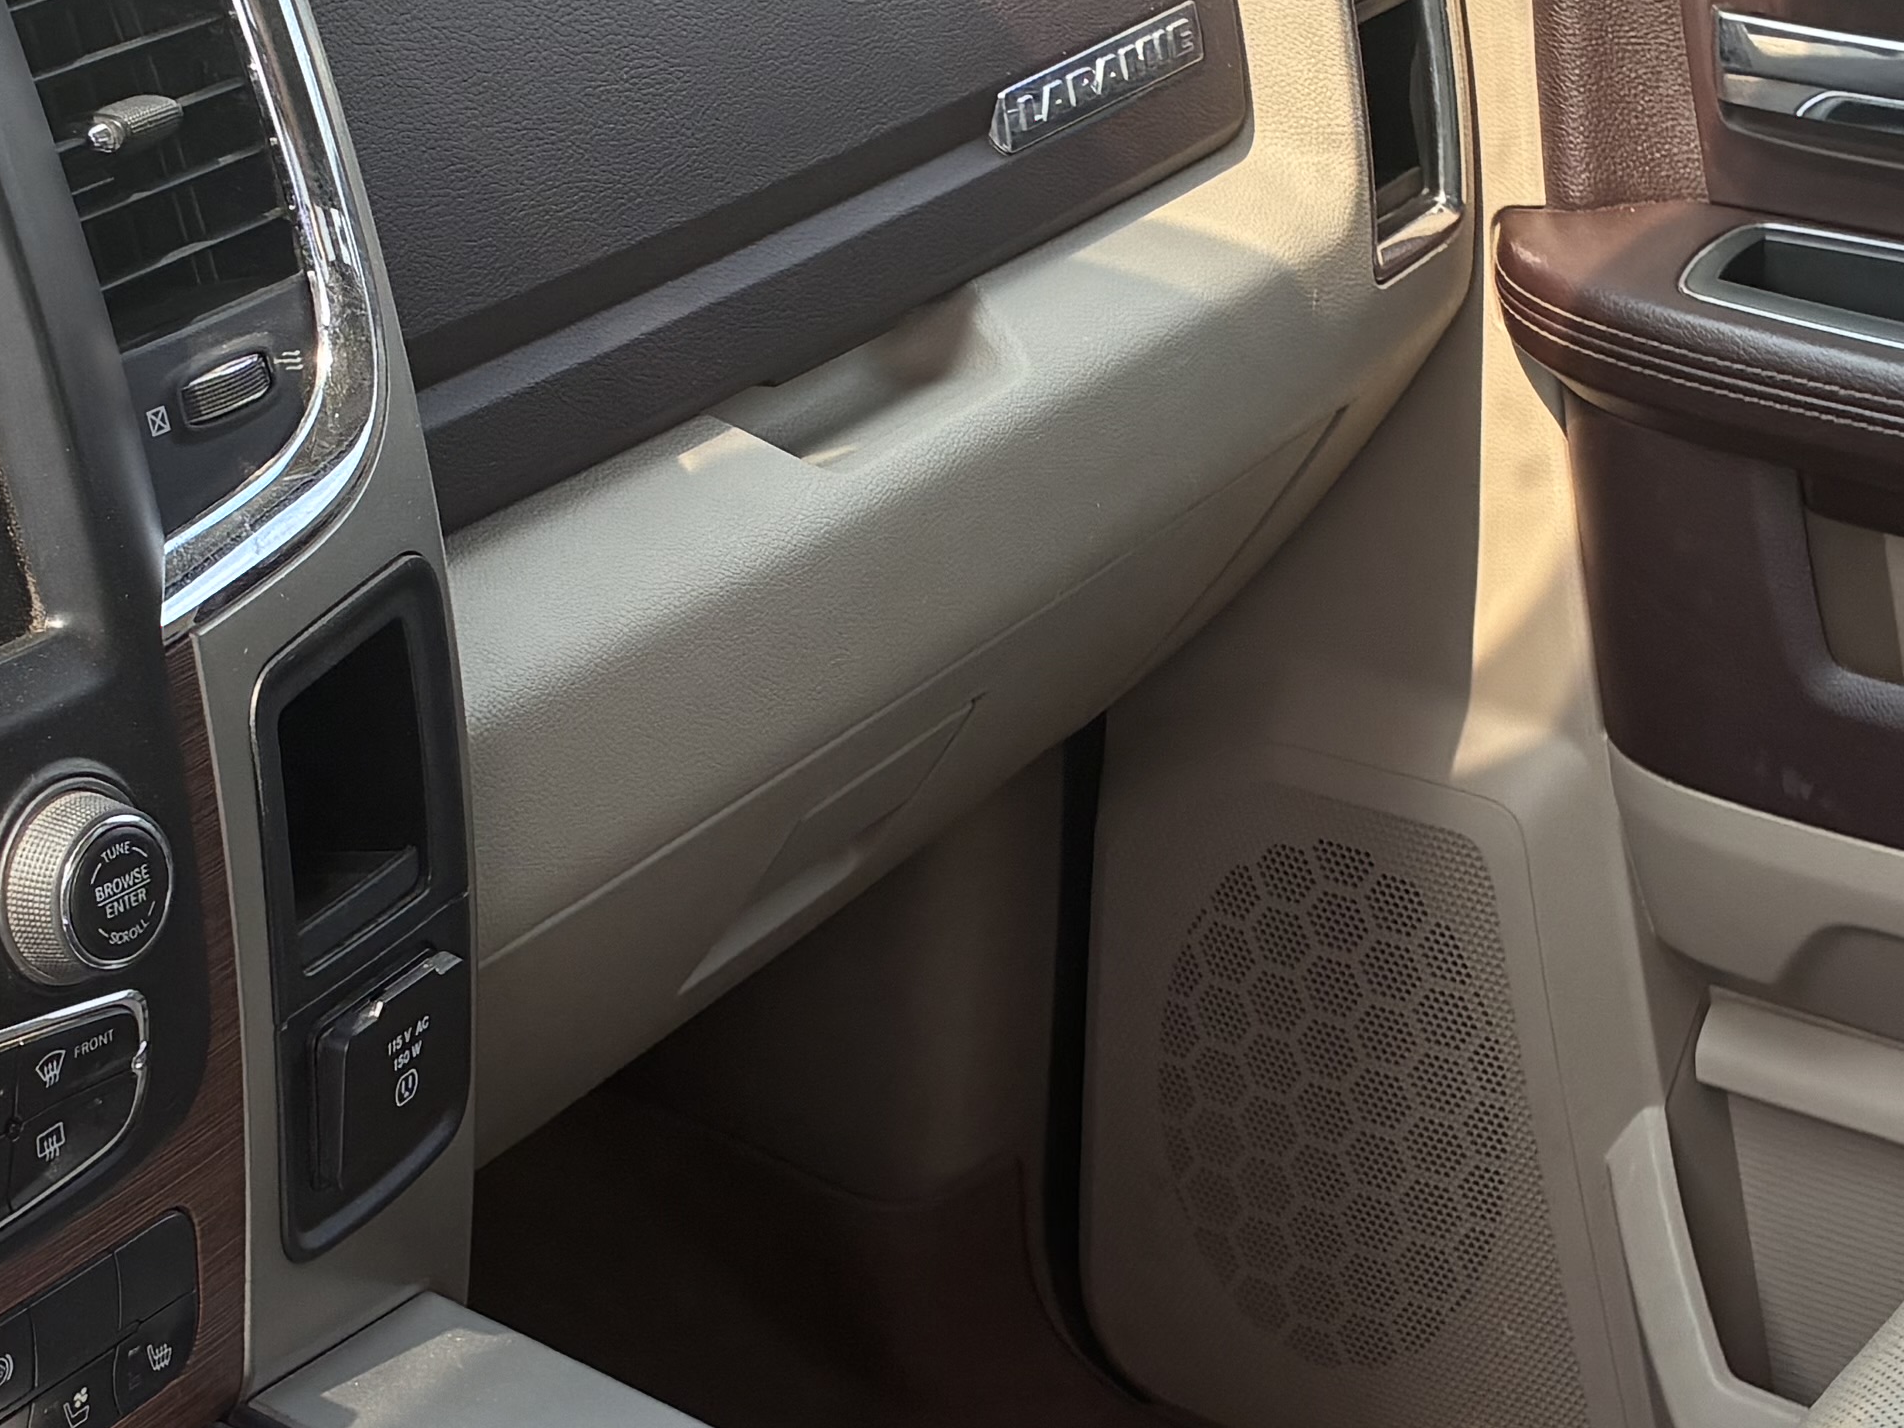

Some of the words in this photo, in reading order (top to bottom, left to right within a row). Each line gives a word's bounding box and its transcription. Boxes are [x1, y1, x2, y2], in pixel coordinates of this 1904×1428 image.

[100, 841, 131, 863] TUNE
[95, 863, 150, 902] BROWSE
[105, 888, 147, 919] ENTER
[109, 919, 150, 945] SCROLL
[73, 1028, 115, 1059] FRONT
[387, 1034, 403, 1056] 115
[404, 1027, 412, 1043] V
[415, 1015, 430, 1036] AC
[393, 1050, 410, 1071] 150
[411, 1039, 422, 1058] W
